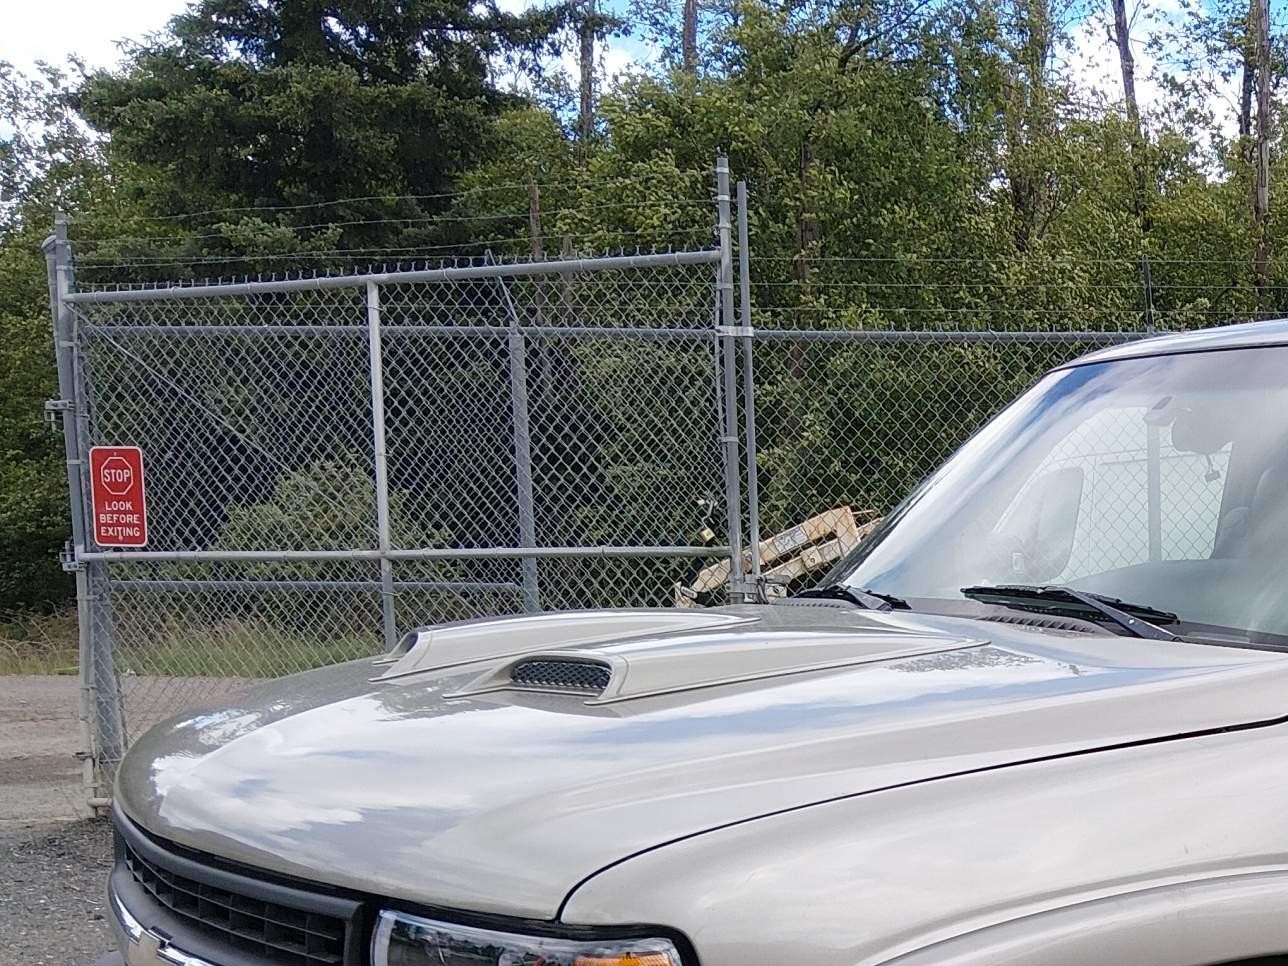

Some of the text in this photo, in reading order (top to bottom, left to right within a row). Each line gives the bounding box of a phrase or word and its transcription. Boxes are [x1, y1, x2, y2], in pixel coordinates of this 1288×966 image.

[104, 470, 130, 482] STOP
[105, 501, 132, 511] LOOK
[99, 514, 141, 524] BEFORE
[100, 526, 140, 537] EXITING
